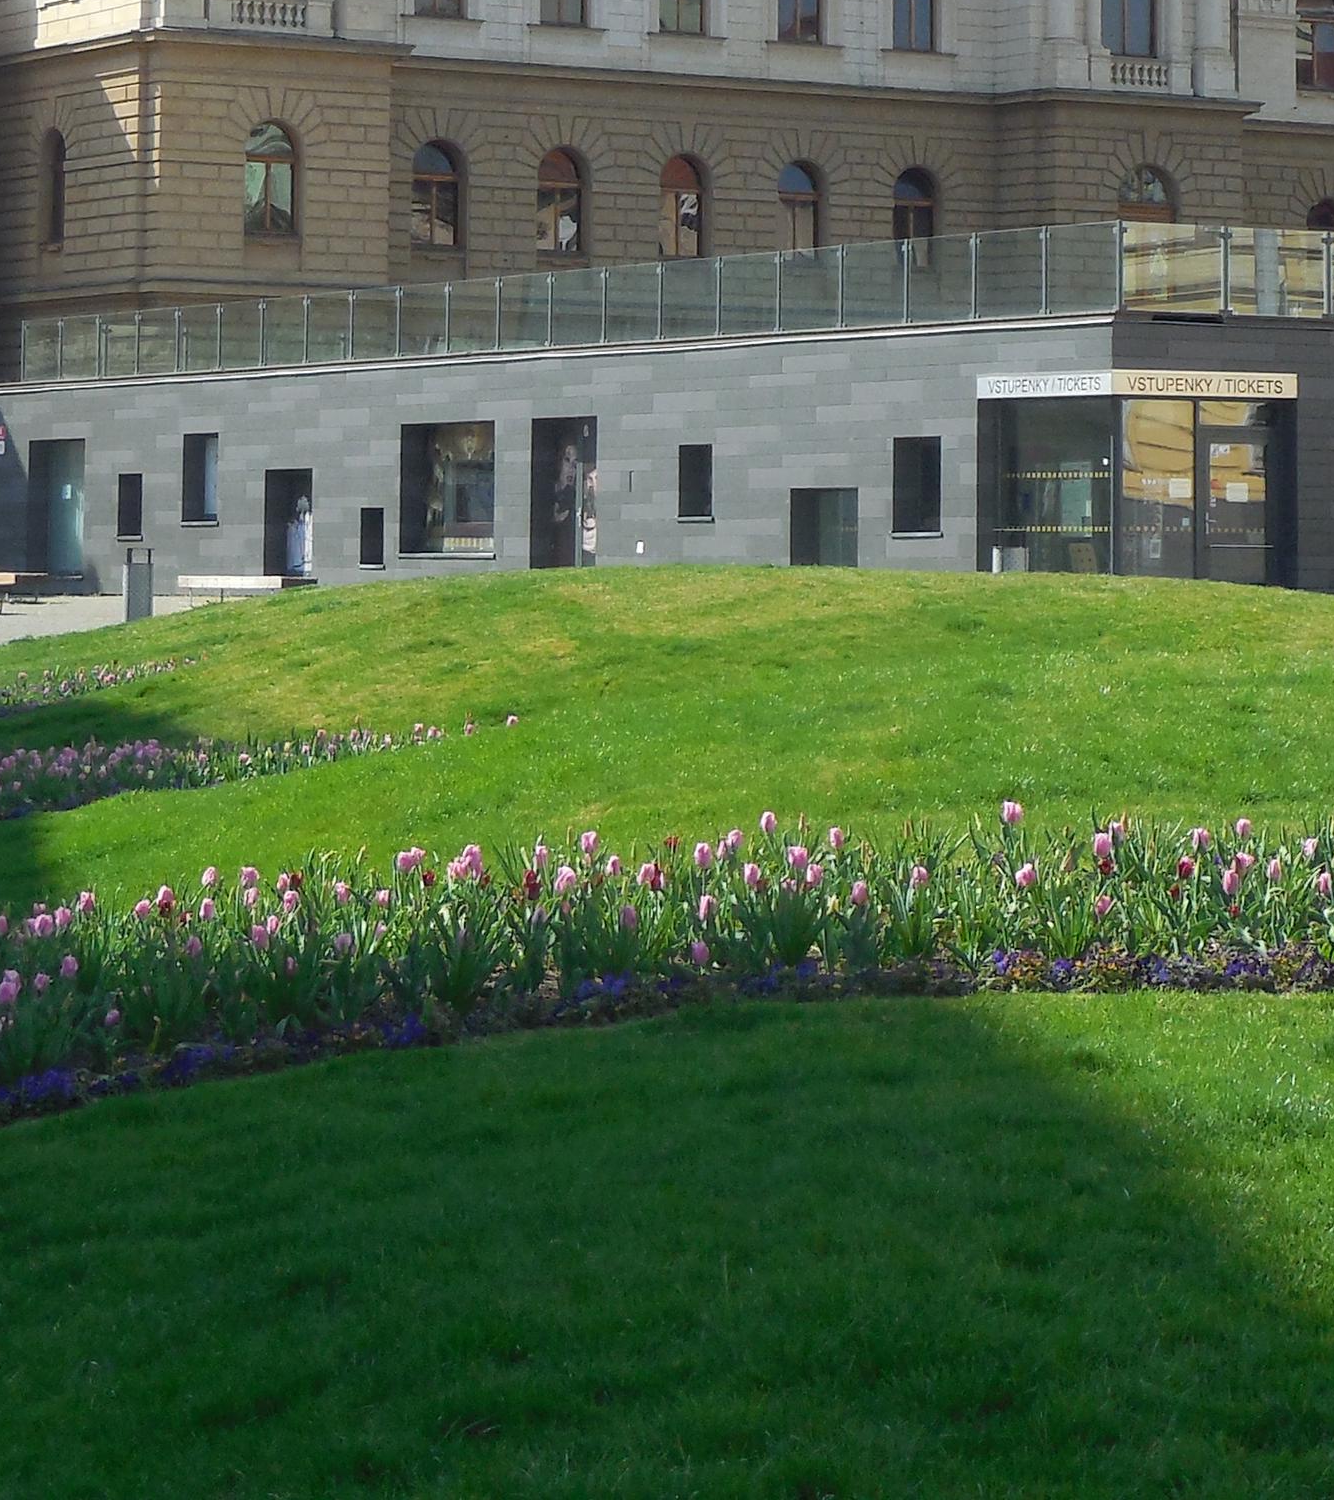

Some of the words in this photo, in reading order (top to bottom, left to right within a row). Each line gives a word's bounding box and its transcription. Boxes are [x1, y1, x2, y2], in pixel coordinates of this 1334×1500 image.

[988, 379, 1049, 394] VSTUPENKY
[1057, 376, 1101, 391] TICKETS
[1127, 376, 1213, 392] VSTUPENKY
[1224, 379, 1284, 394] TICKETS
